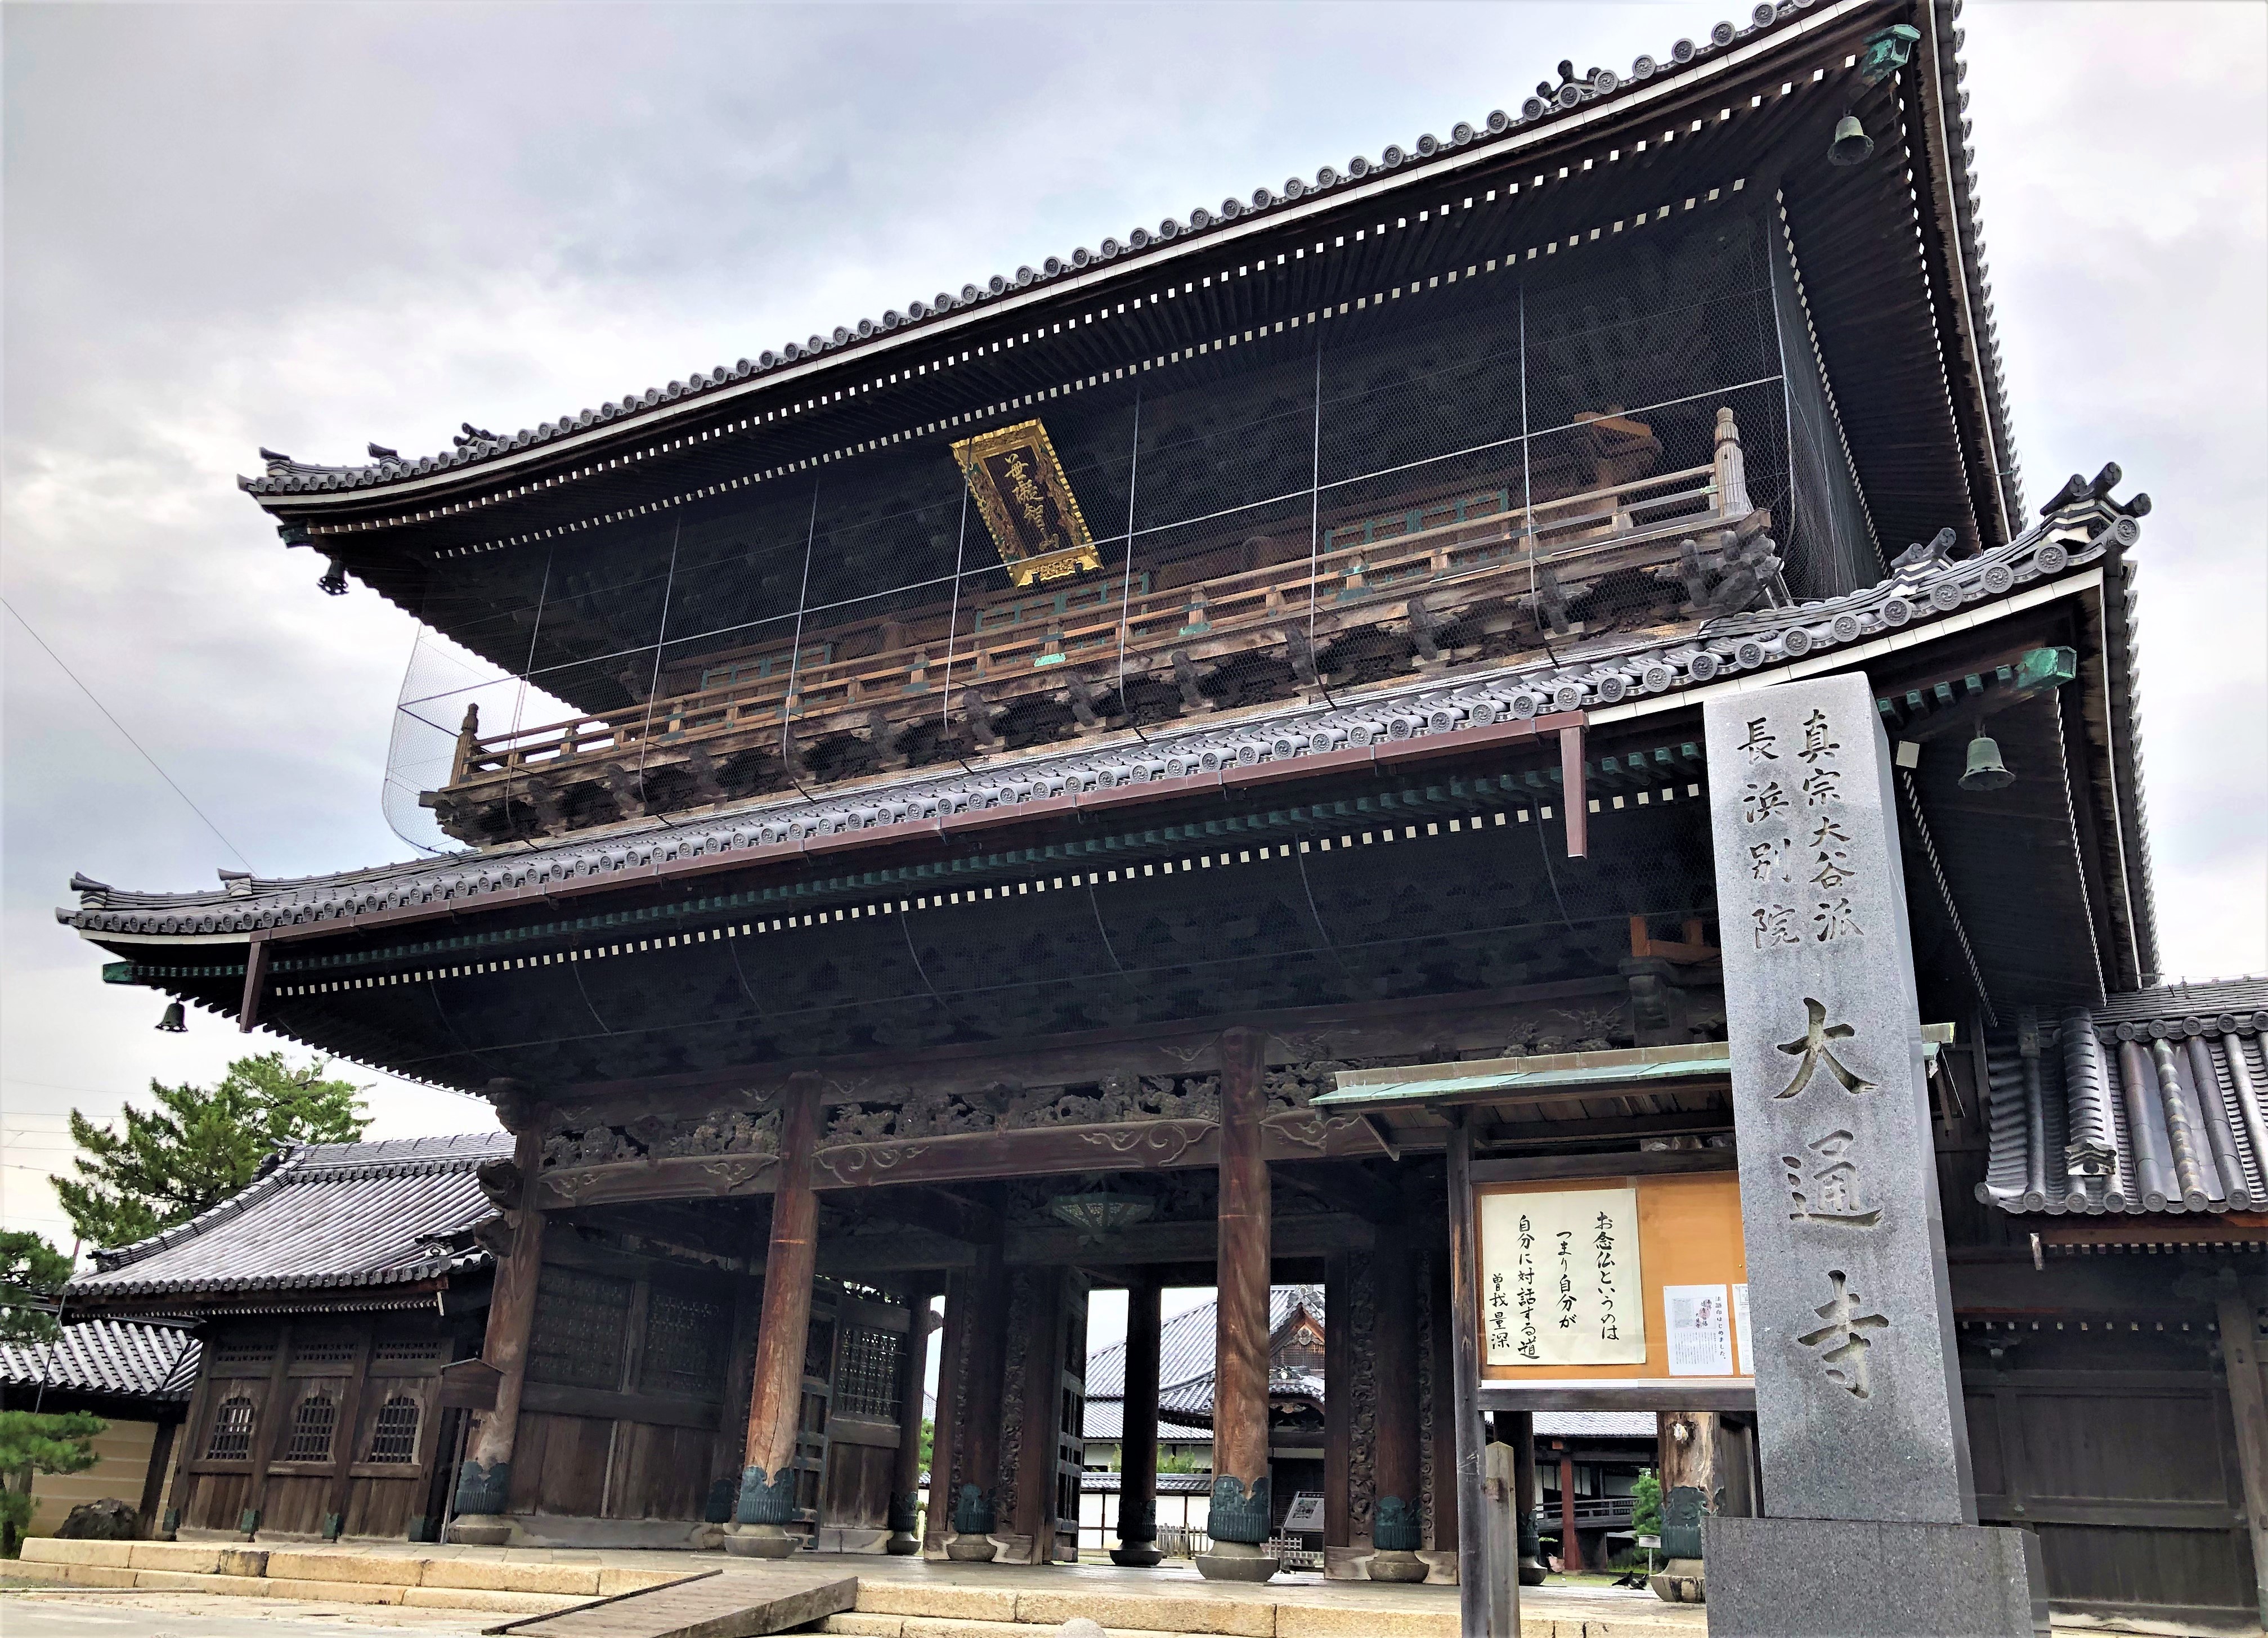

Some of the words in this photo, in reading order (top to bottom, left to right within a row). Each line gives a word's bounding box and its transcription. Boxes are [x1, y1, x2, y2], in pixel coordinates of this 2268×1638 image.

[1737, 716, 1800, 949] 長浜別院
[1797, 709, 1864, 943] 真宗大谷派
[1517, 1214, 1540, 1360] 自分に対話する道
[1556, 1231, 1577, 1329] つまり自分が
[1592, 1211, 1620, 1341] お念仏というのは
[1774, 997, 1889, 1399] 大通寺
